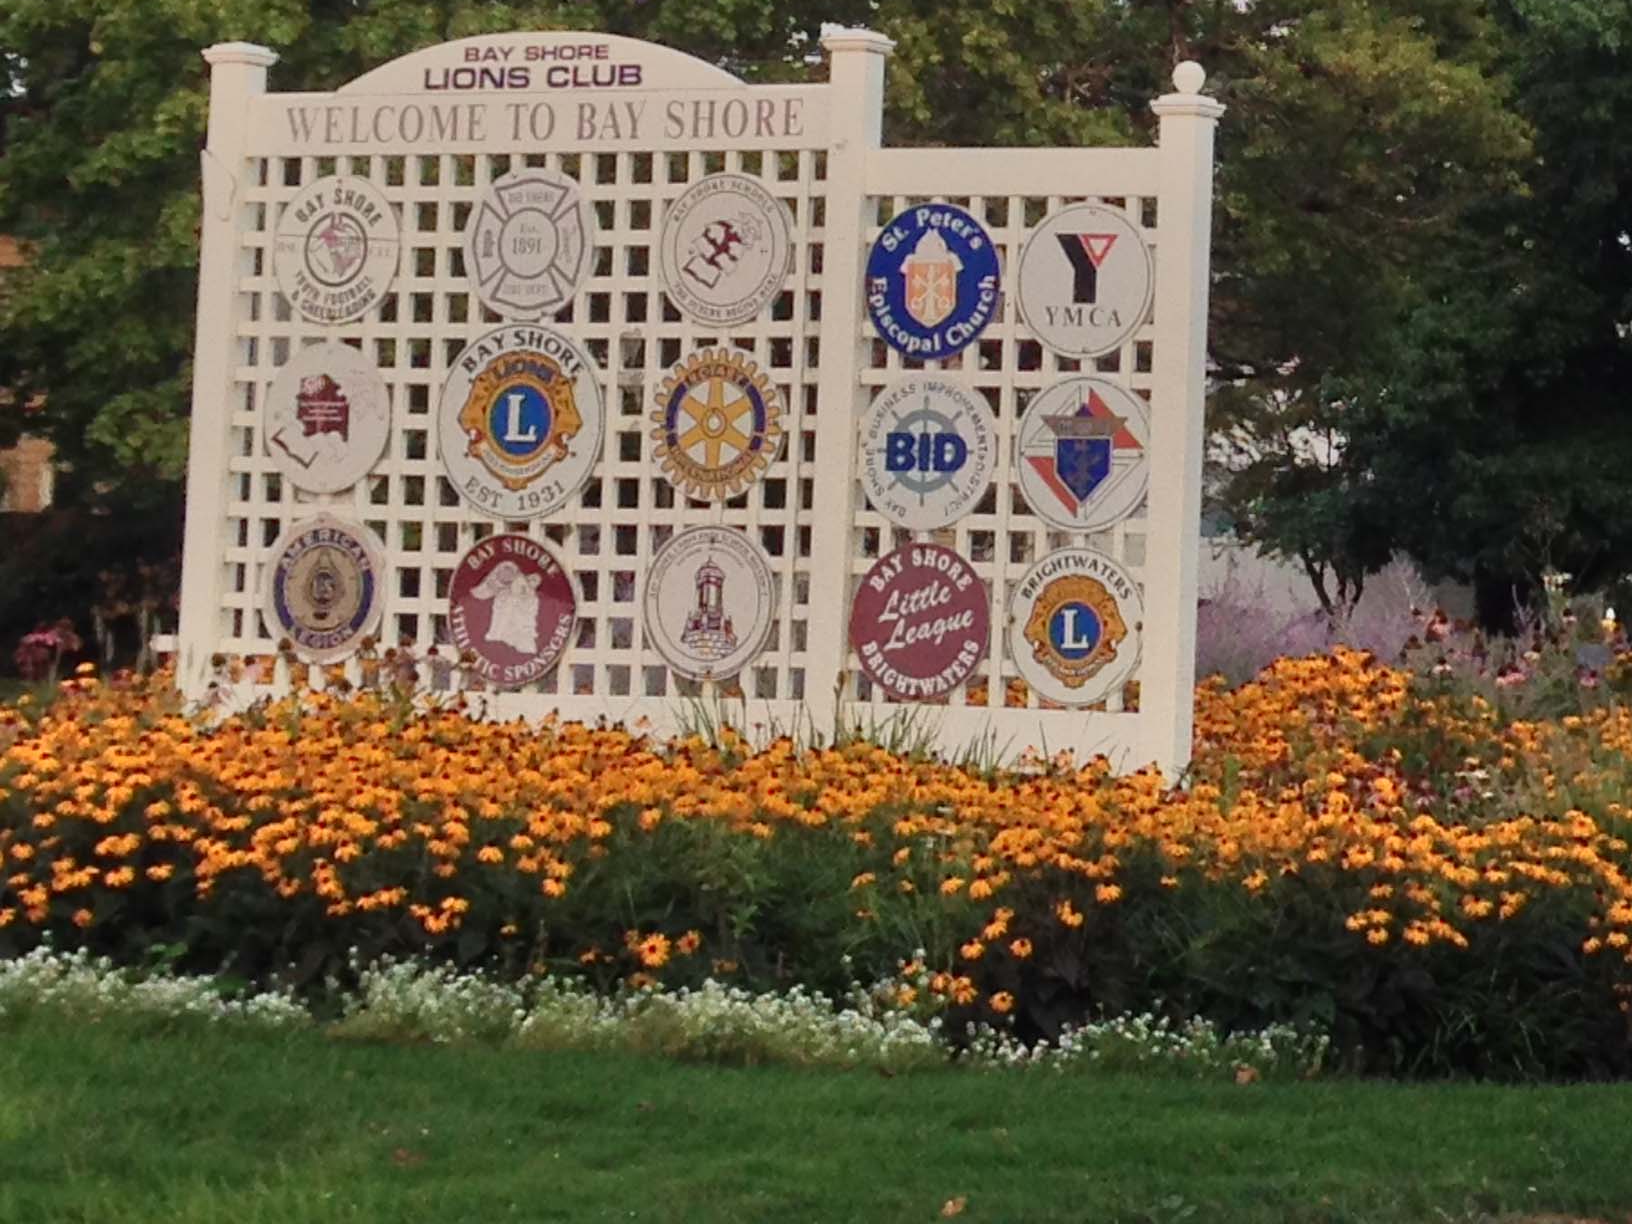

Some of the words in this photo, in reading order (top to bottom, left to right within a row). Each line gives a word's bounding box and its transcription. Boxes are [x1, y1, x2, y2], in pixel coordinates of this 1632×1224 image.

[465, 46, 515, 63] BAY
[524, 44, 609, 62] SHORE
[424, 66, 530, 91] LIONS
[546, 64, 643, 88] CLUB
[286, 103, 488, 145] WELCOME
[506, 101, 556, 142] TO
[576, 99, 647, 141] BAY
[664, 98, 804, 139] SHORE
[295, 192, 325, 223] BAY
[334, 188, 383, 227] SHORE
[512, 237, 543, 256] 1891
[881, 227, 910, 253] St.
[869, 276, 942, 353] Episcopal
[945, 275, 996, 346] Church
[1045, 305, 1122, 328] YMCA
[461, 333, 505, 374] BAY
[513, 328, 585, 376] SHORE
[504, 393, 537, 443] L
[885, 432, 968, 473] BID
[464, 475, 504, 508] EST
[517, 479, 566, 511] 1931
[280, 527, 372, 572] AMERICAN
[467, 541, 496, 570] BAY
[501, 537, 559, 576] SHORE
[870, 554, 904, 593] BAY
[911, 548, 974, 592] SHORE
[1021, 554, 1134, 601] BRIGHTWATERS
[878, 580, 953, 624] Little
[452, 604, 501, 682] ATHLTIC
[503, 612, 572, 682] SPONSORS
[883, 609, 975, 652] League
[1060, 608, 1090, 650] L
[861, 639, 980, 696] BRIGHTWATERS
